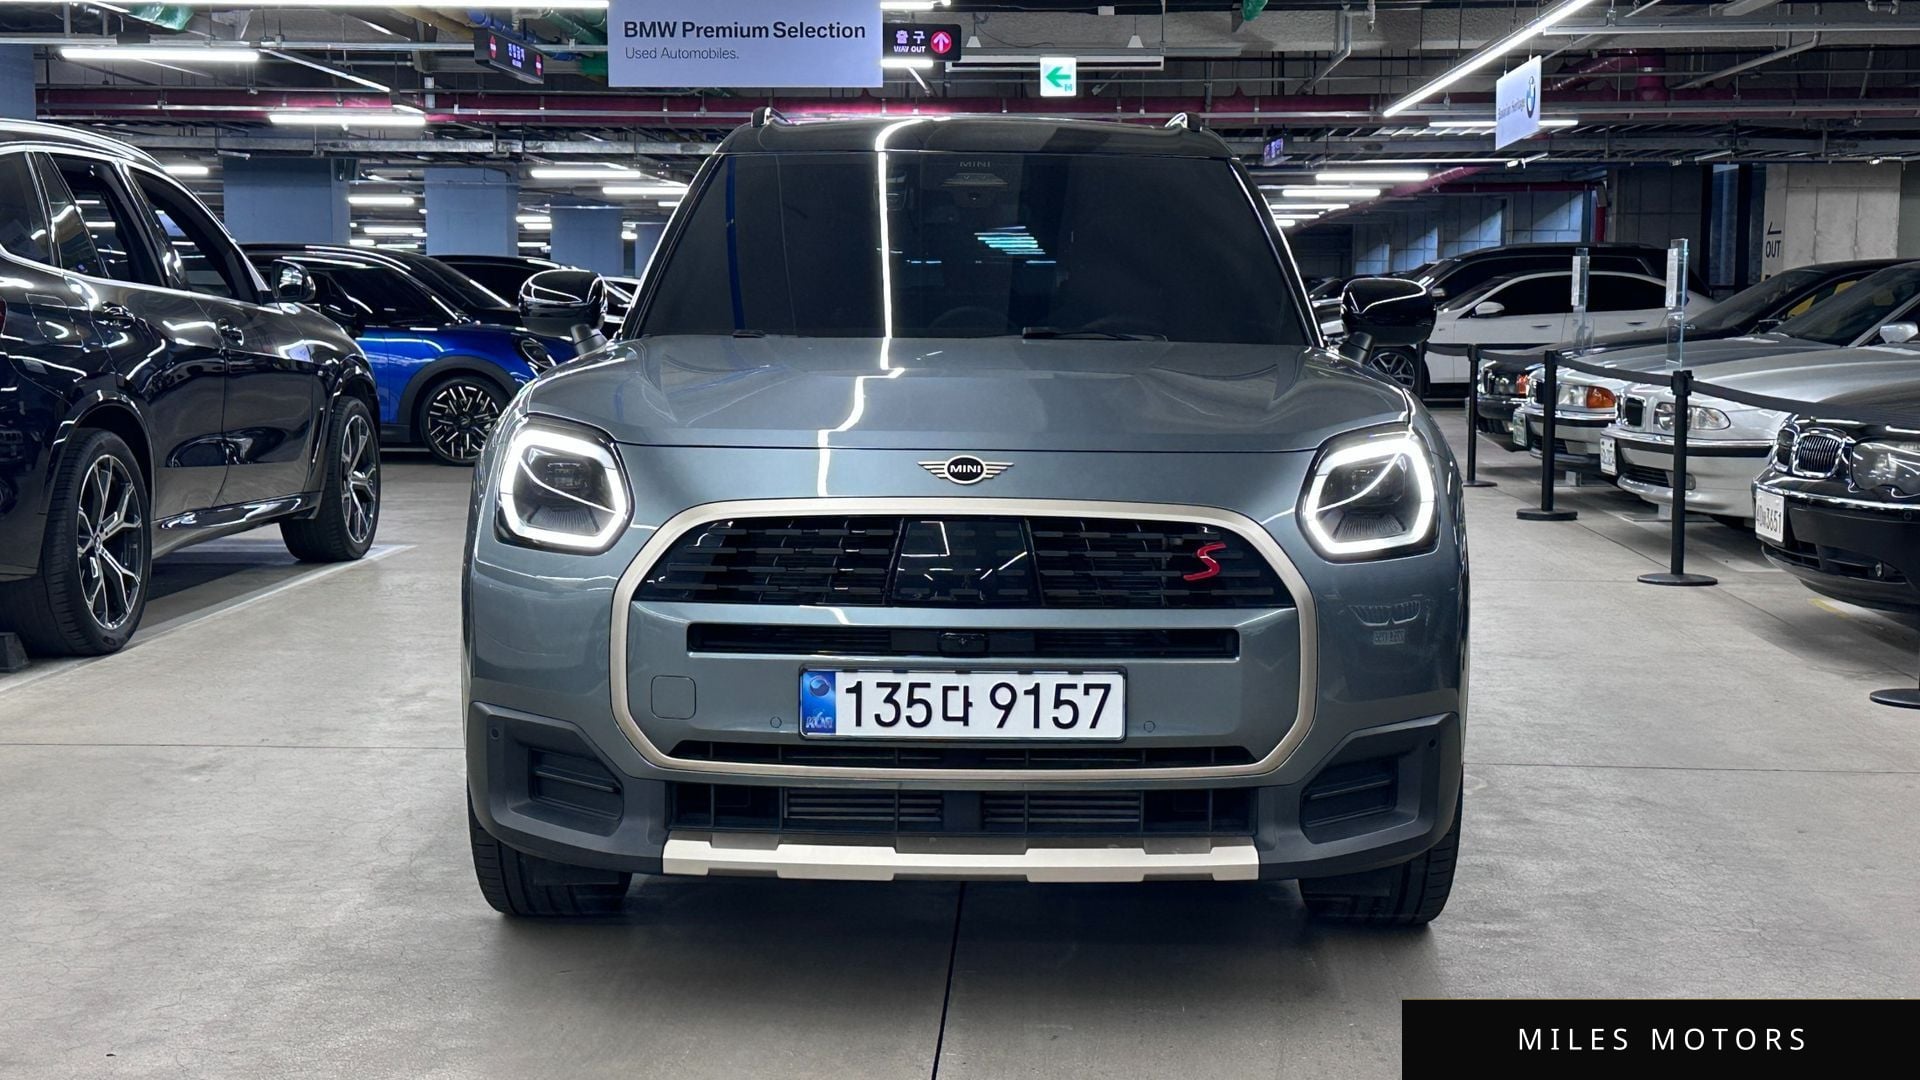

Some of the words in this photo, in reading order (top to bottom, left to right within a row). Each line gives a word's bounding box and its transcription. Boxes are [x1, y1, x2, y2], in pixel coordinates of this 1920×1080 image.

[624, 20, 677, 38] BMW
[682, 21, 769, 38] Premium
[772, 20, 865, 38] Selection
[625, 46, 657, 60] Used
[661, 46, 740, 60] Automobiles.
[911, 45, 926, 53] OUT
[1765, 239, 1781, 258] OUT
[949, 464, 981, 473] MINI
[1183, 542, 1226, 581] S
[845, 680, 973, 728] 135다
[989, 681, 1112, 729] 9157
